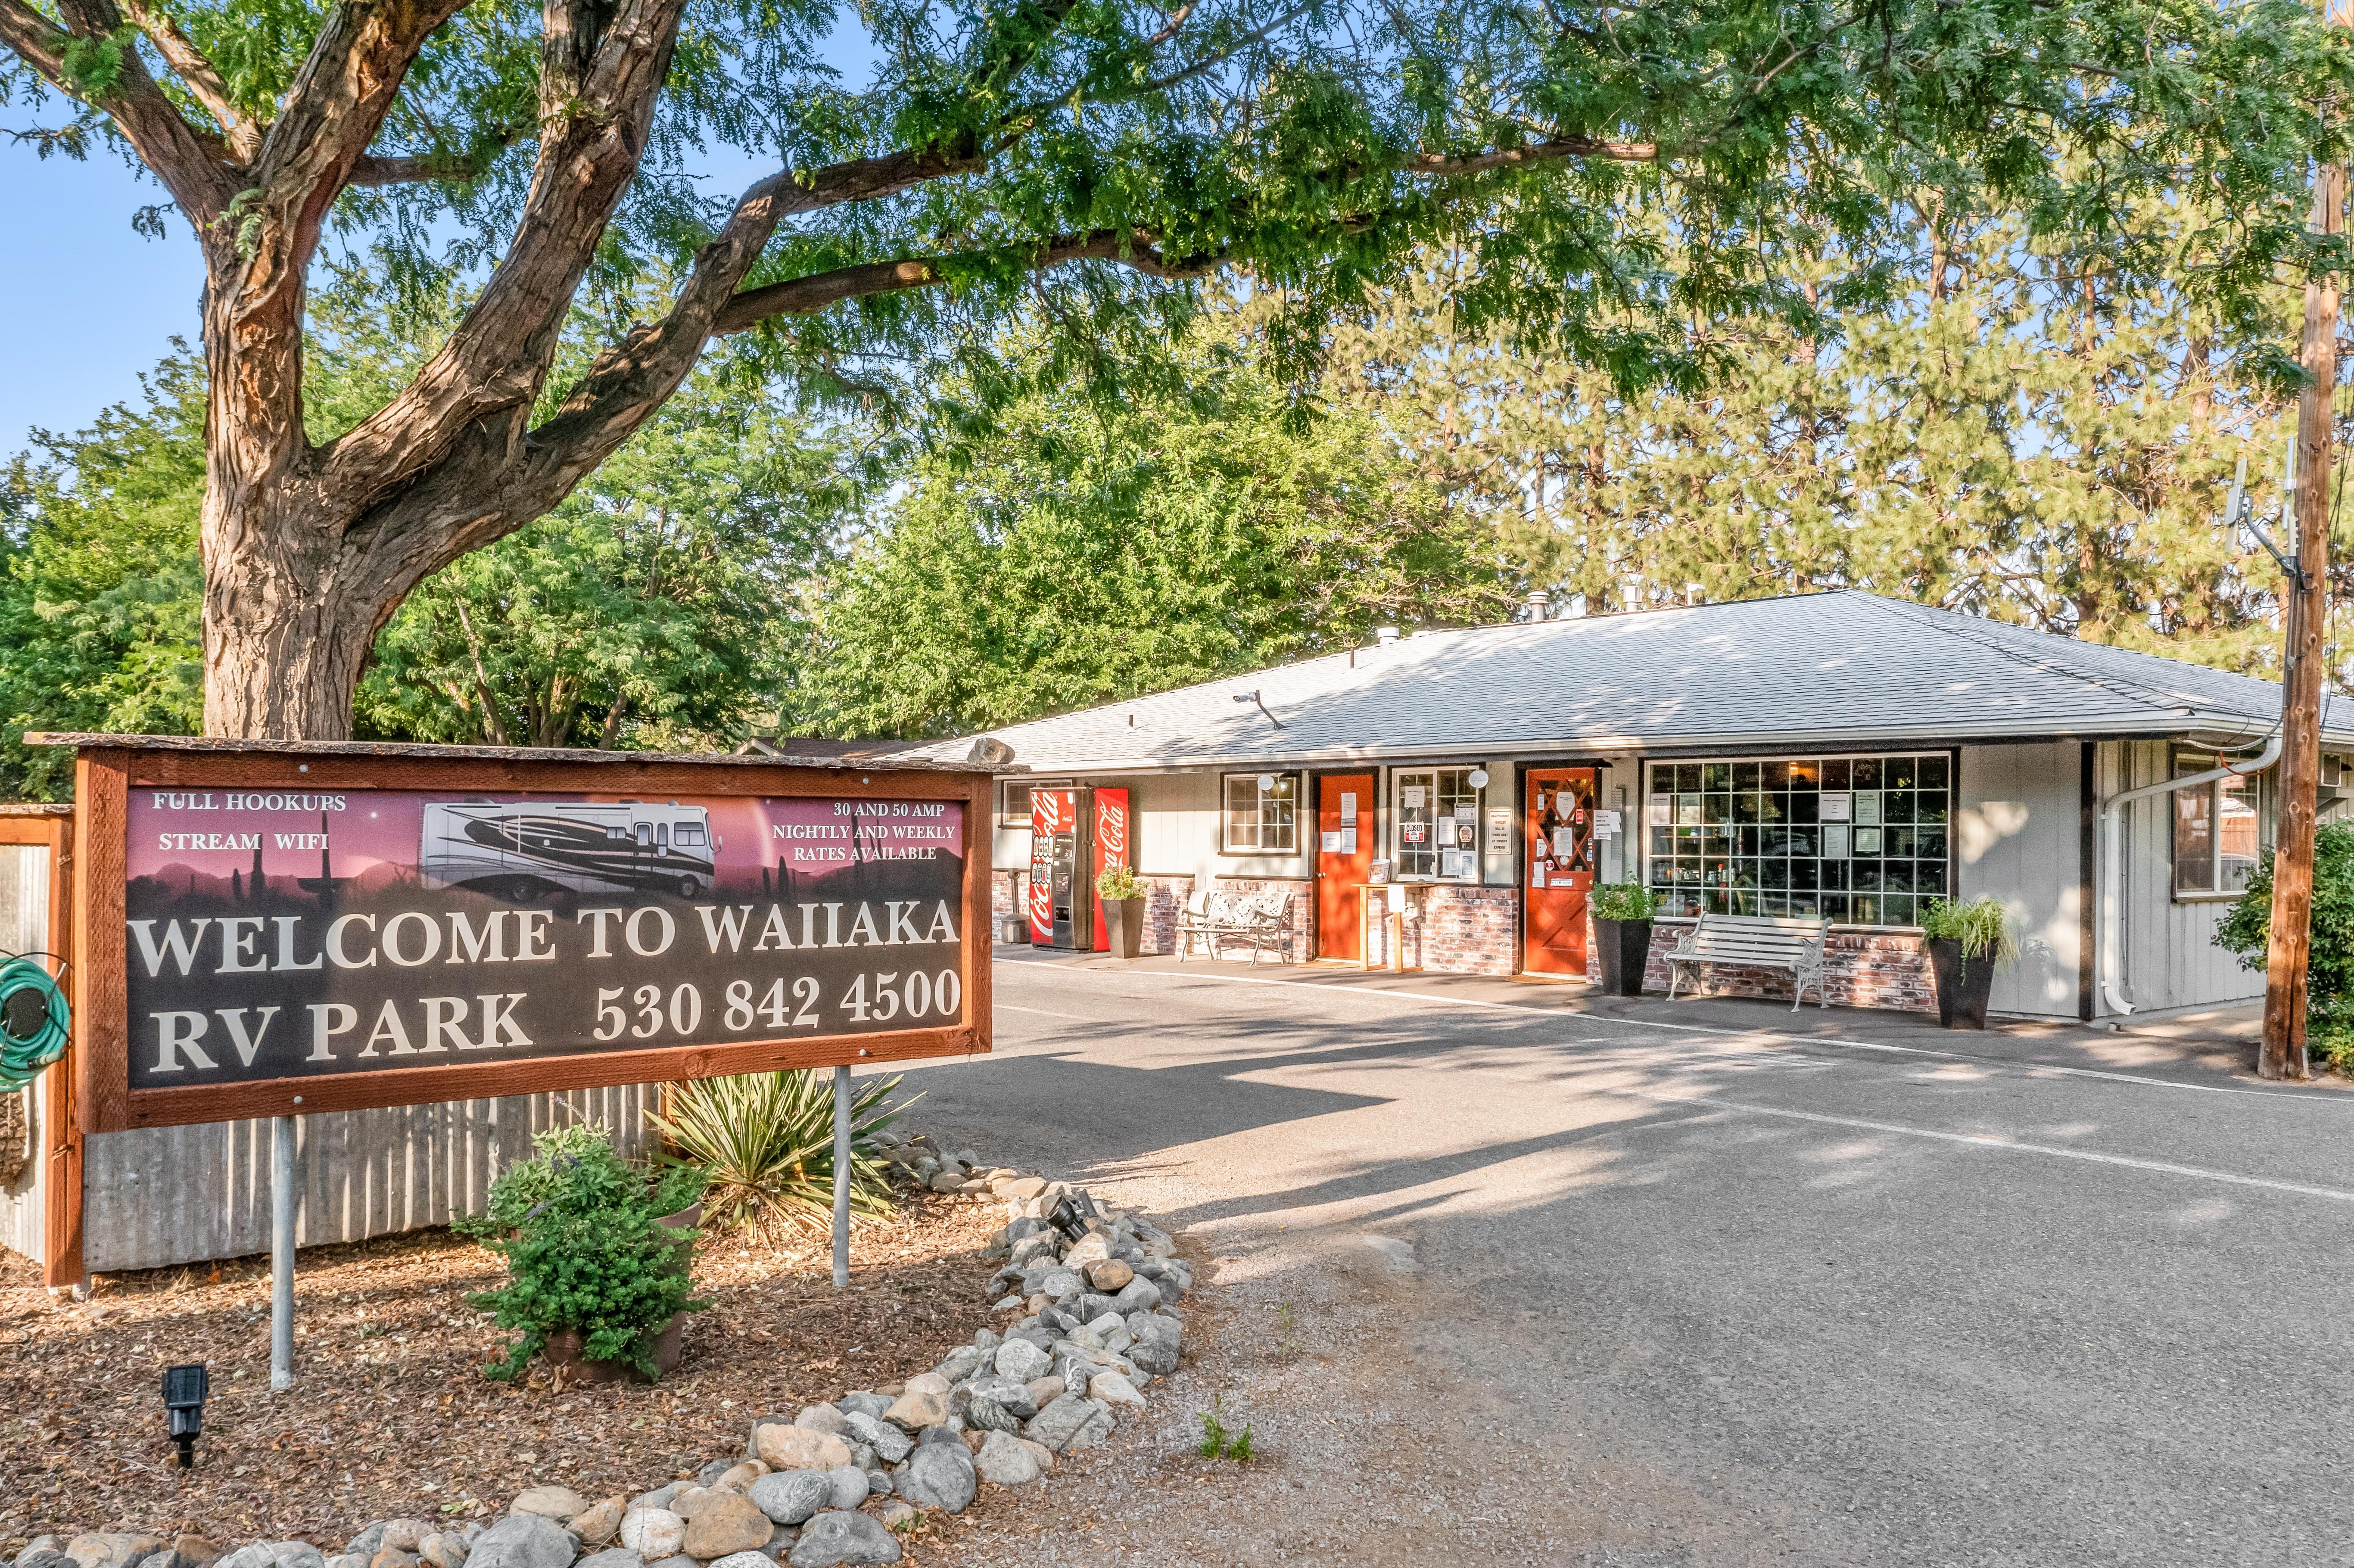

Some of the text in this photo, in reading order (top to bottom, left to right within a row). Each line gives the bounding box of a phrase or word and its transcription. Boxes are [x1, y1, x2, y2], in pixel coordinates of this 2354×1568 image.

[152, 793, 346, 812] FULL HOOKUPS
[834, 803, 945, 817] 30 AND 50 AMP
[772, 824, 955, 840] NIGHTLY AND WEEKLY
[159, 833, 329, 850] STREAM WIFI
[794, 846, 937, 862] RATES AVAILABLE
[126, 899, 960, 978] WELCOME TO WAIIAKA
[149, 969, 961, 1073] RV PARK 530 842 4500
